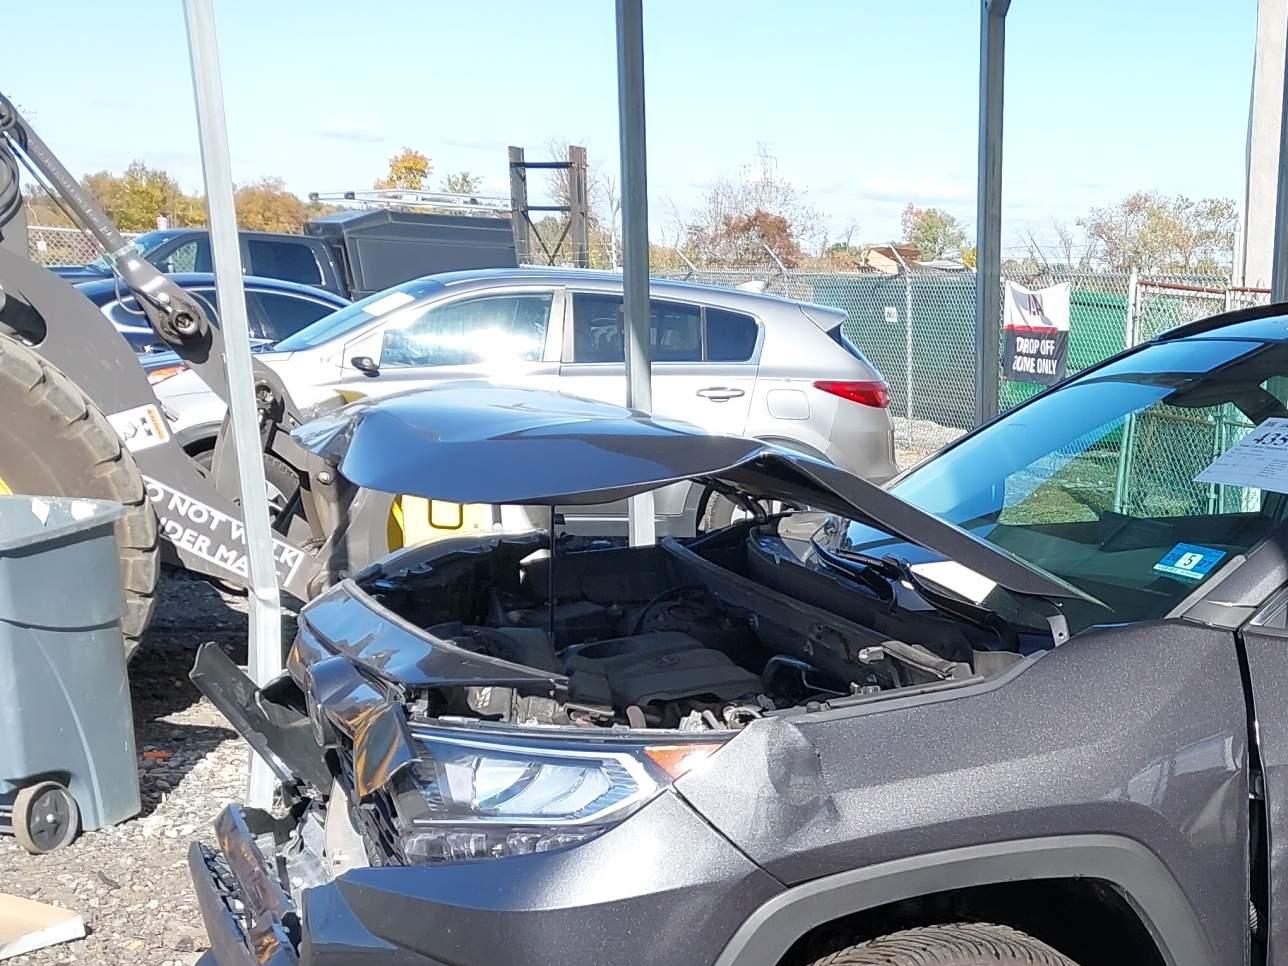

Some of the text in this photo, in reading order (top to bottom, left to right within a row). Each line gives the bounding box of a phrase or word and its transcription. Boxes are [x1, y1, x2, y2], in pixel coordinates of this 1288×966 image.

[1016, 336, 1056, 356] DROP OFF
[1036, 358, 1058, 375] ONLY
[168, 492, 226, 531] NOT
[1183, 554, 1198, 567] 5
